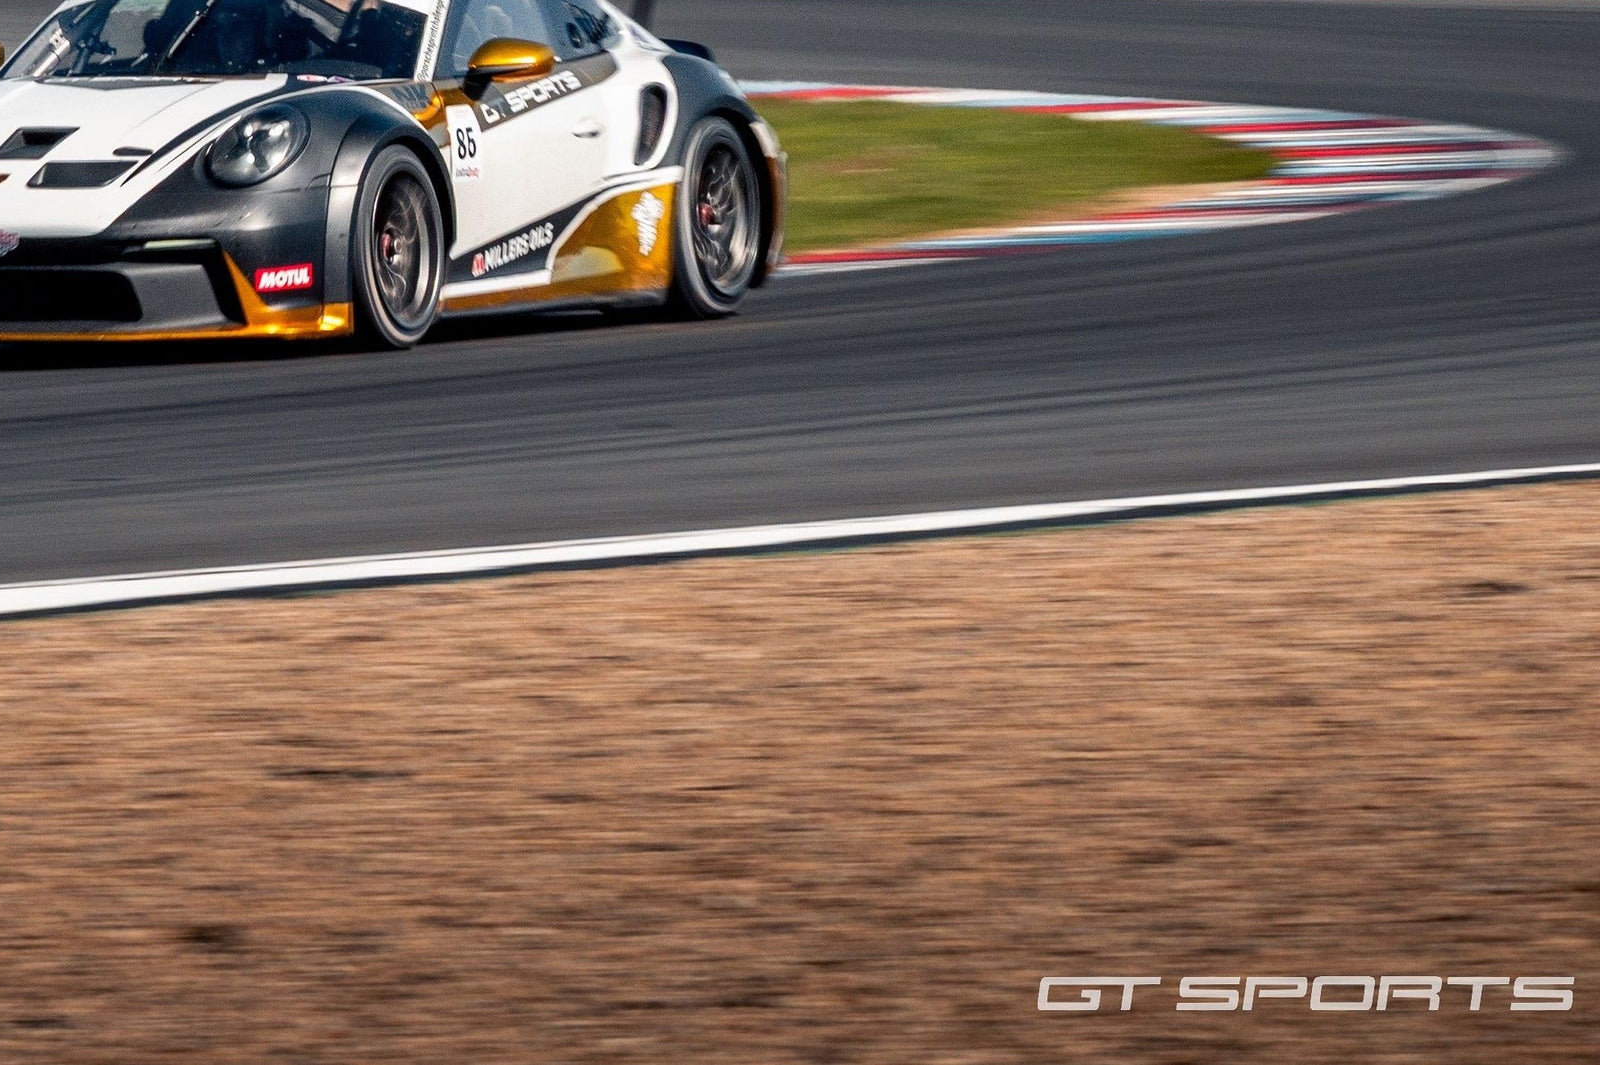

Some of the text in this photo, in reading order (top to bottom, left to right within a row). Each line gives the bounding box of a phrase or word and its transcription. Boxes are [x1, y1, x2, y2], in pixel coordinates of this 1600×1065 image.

[504, 70, 582, 113] SPORTS
[484, 222, 554, 272] MILLERS OILS
[258, 267, 310, 289] MOTUL
